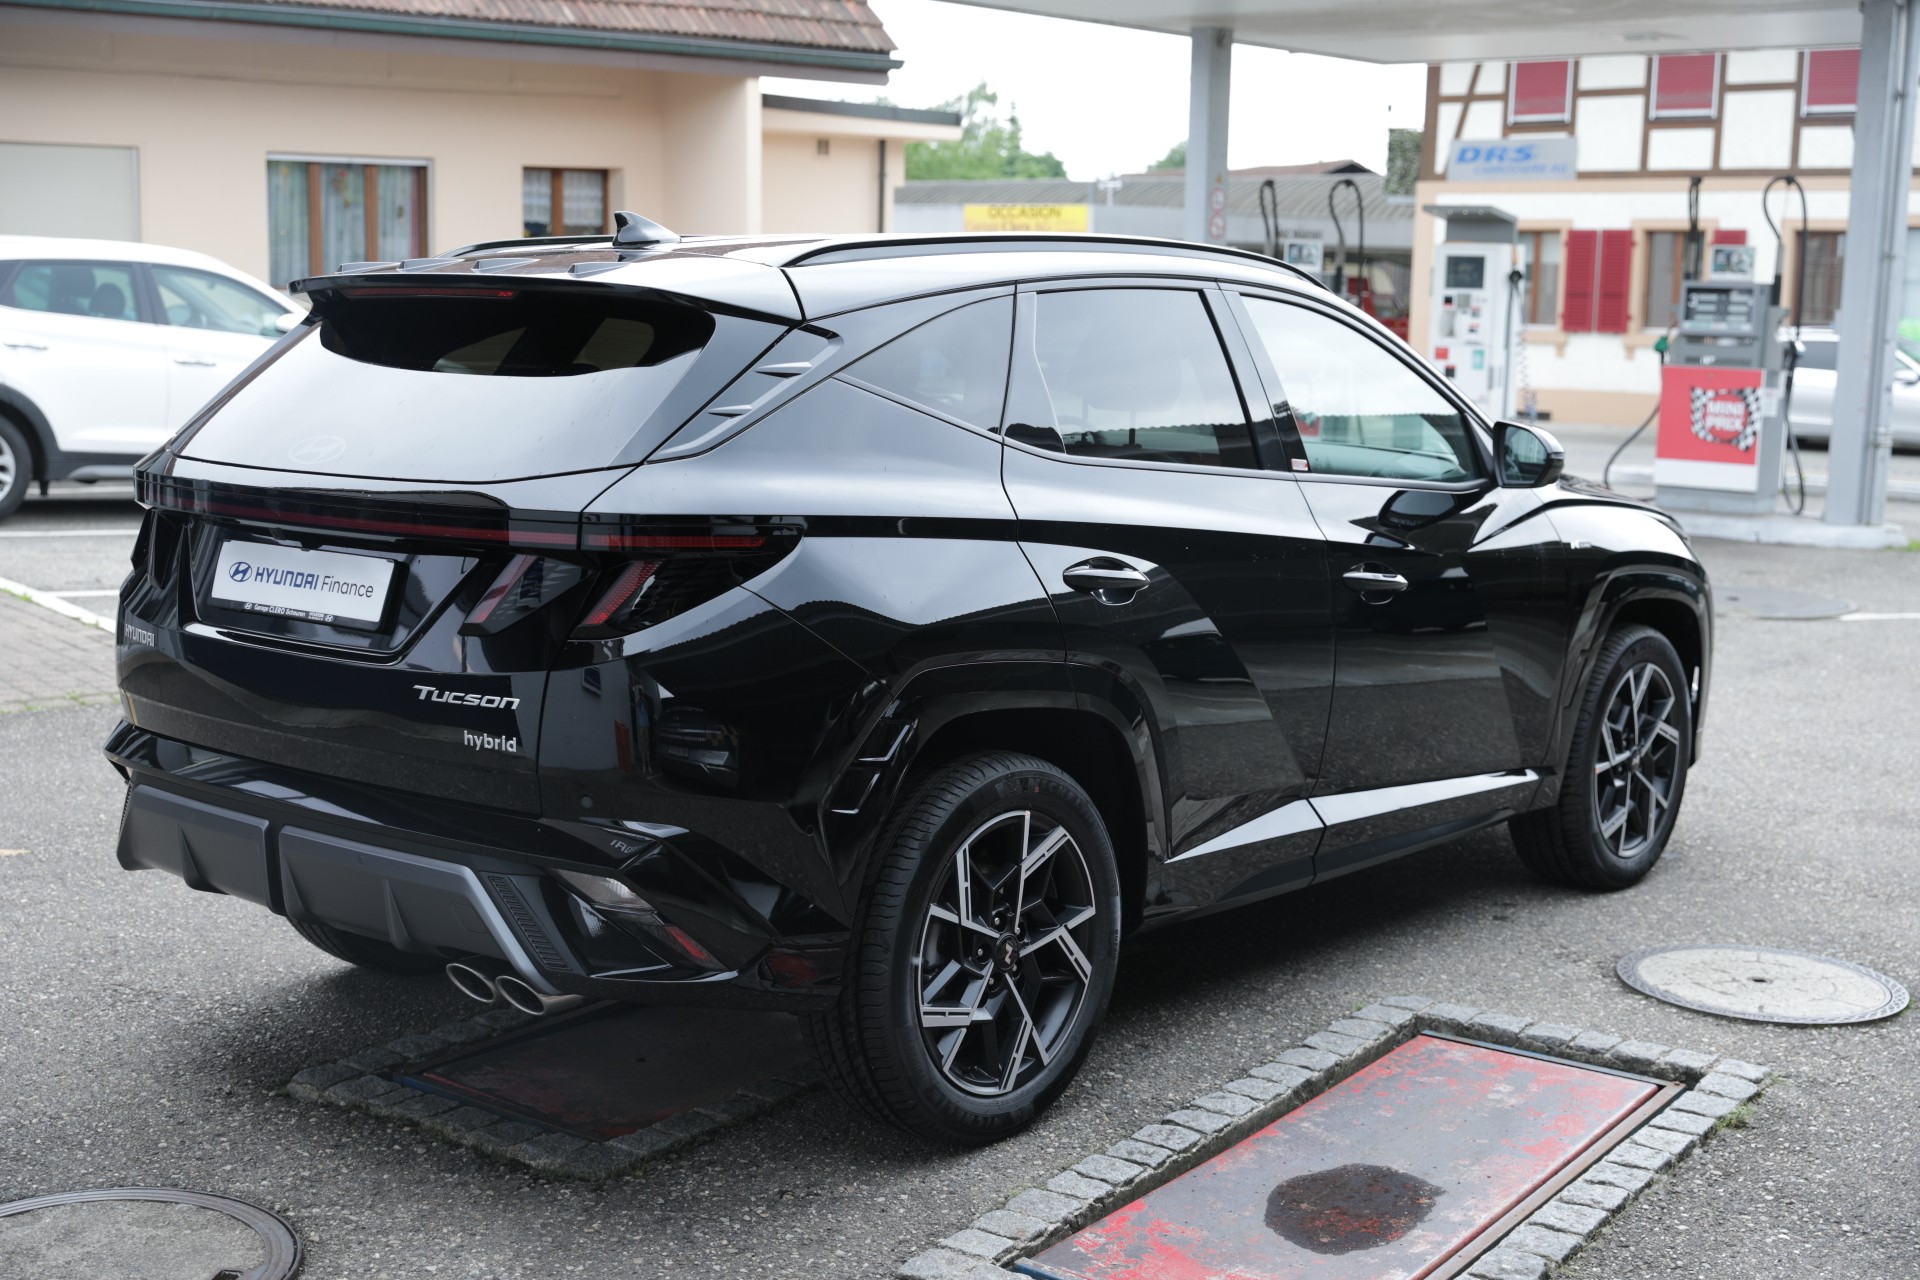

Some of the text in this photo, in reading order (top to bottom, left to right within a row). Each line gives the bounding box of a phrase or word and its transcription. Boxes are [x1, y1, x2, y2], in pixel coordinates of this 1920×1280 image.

[1456, 144, 1537, 163] DRS
[987, 204, 1062, 219] OCCASION
[254, 566, 374, 598] HYUNDAI Finance
[269, 606, 286, 615] CLERO
[125, 623, 155, 648] HYUNDAI
[463, 730, 517, 753] hybrid
